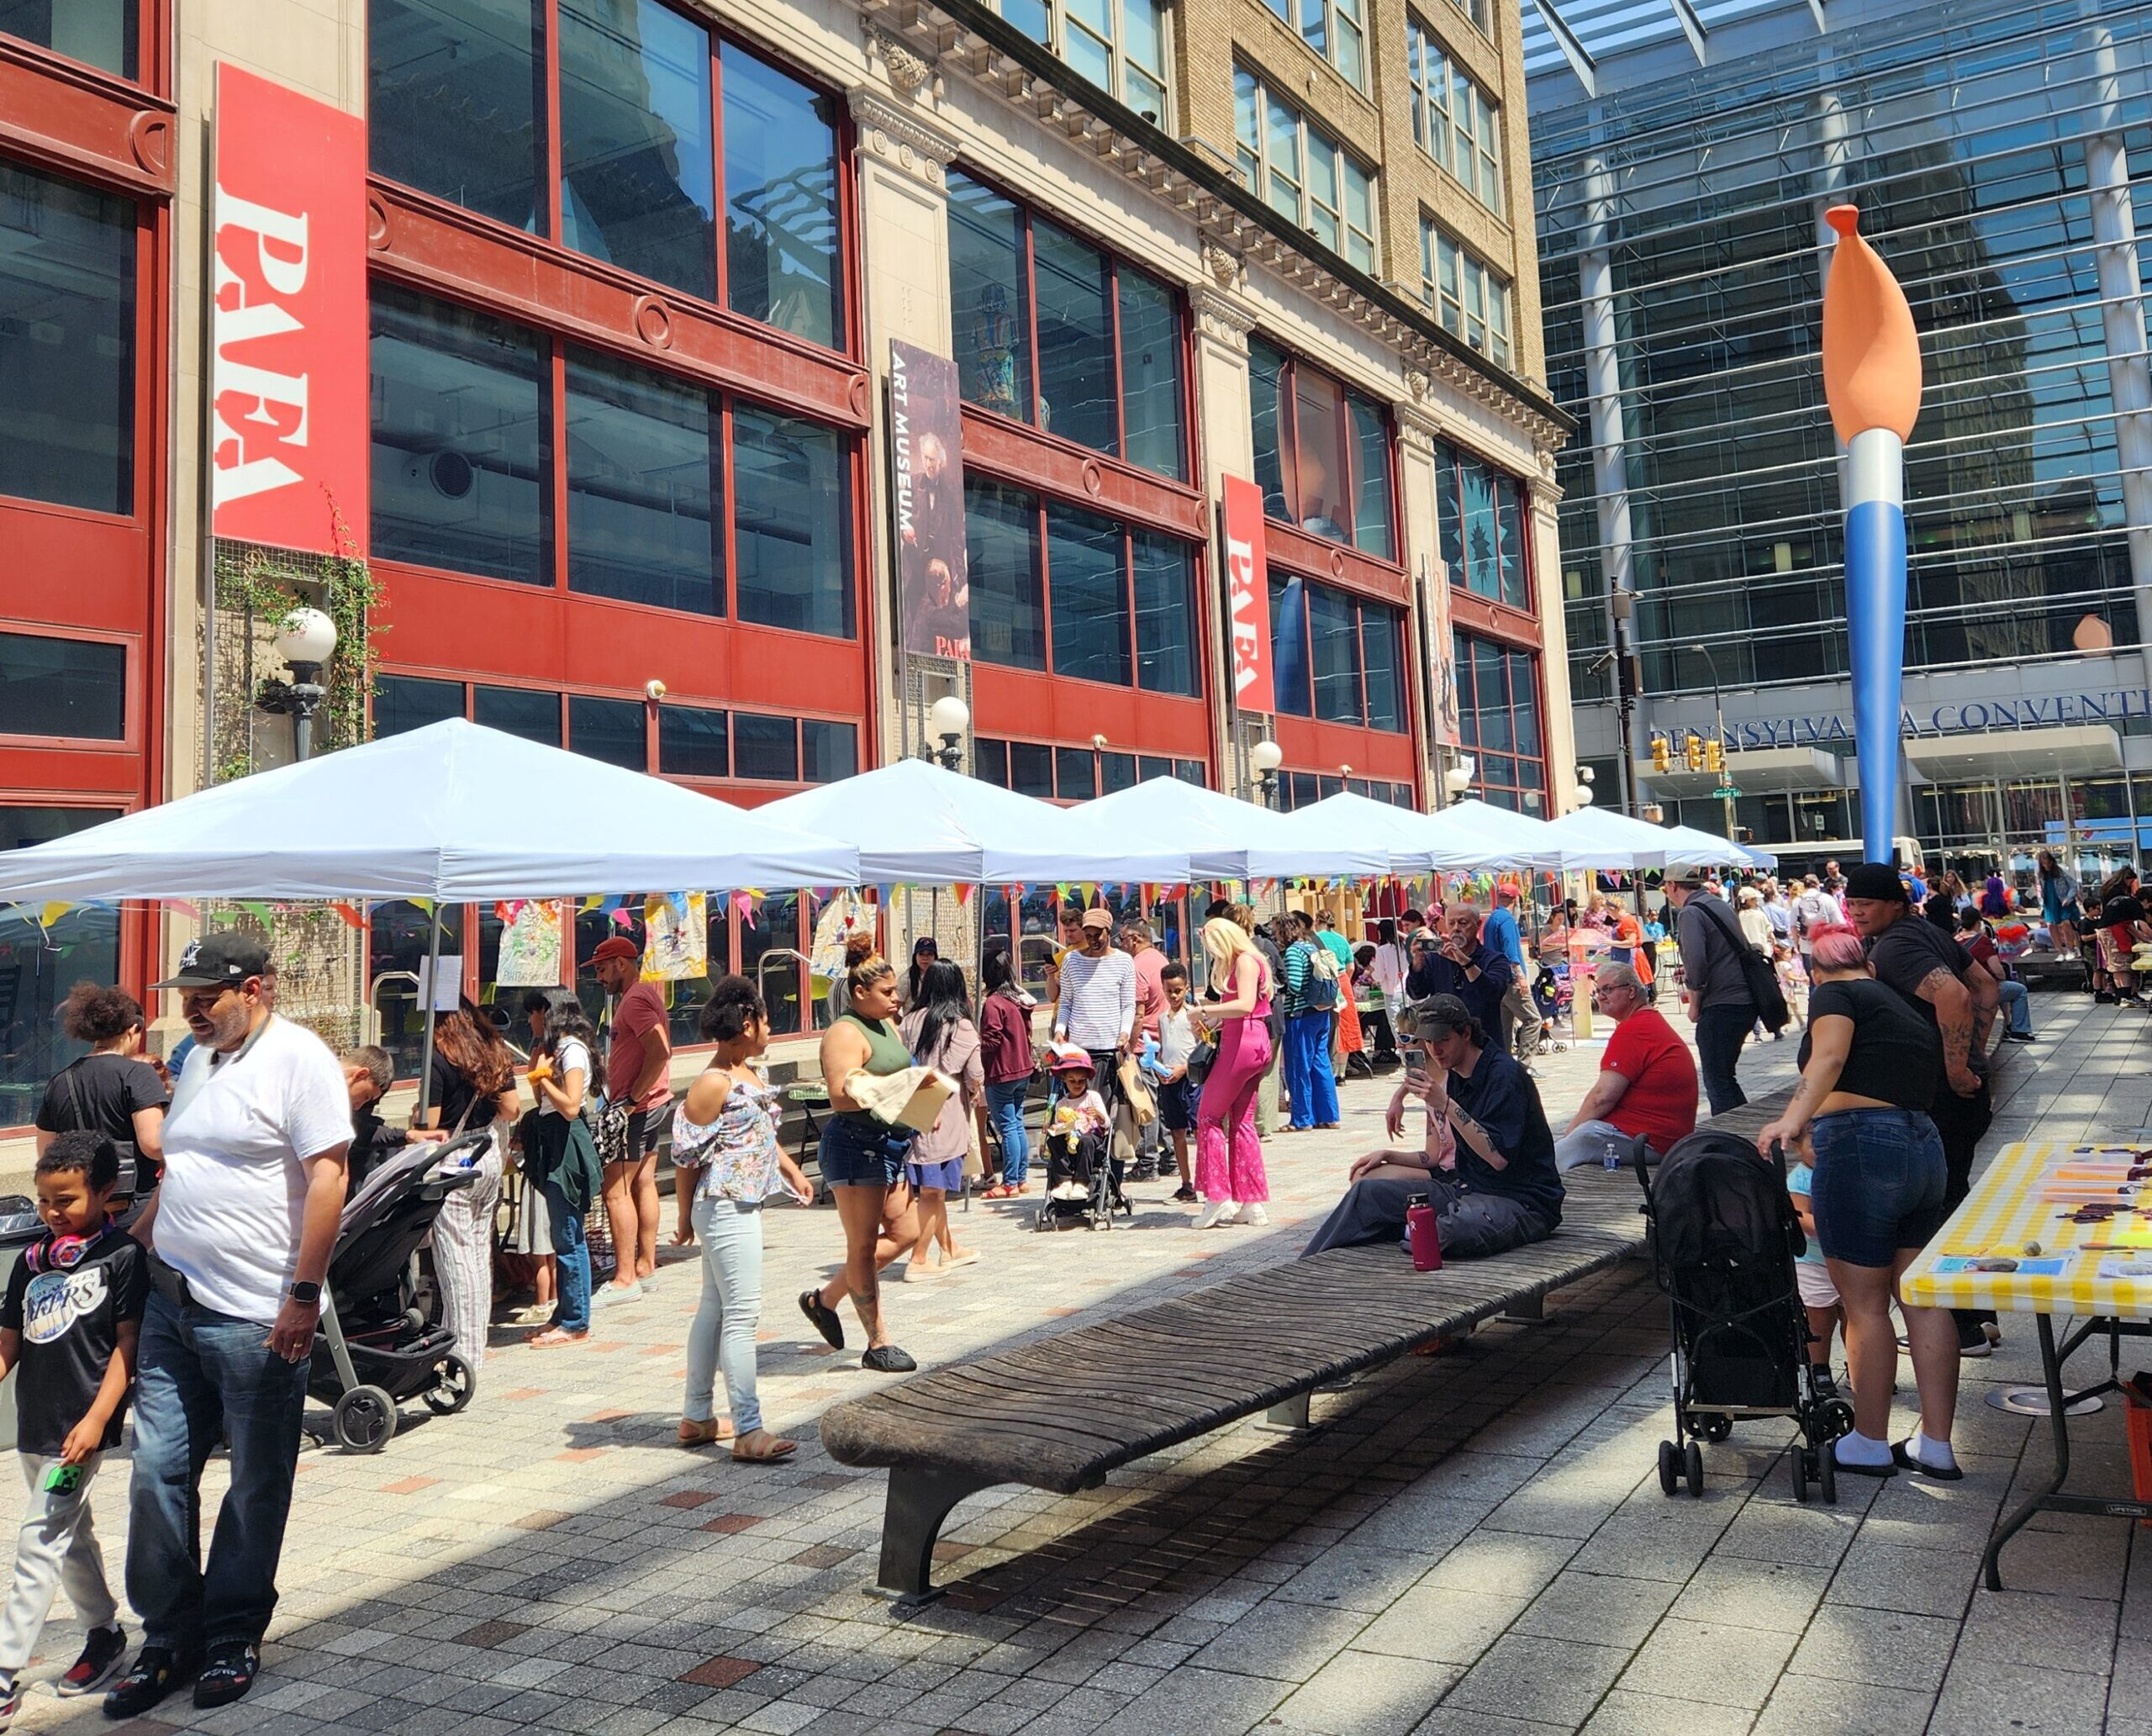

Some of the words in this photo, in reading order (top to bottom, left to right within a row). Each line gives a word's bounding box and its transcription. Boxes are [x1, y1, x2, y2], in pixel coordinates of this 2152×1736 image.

[213, 181, 308, 510] PAFA
[893, 351, 908, 407] ART
[894, 410, 915, 532] MUSEUM
[1227, 533, 1258, 696] PAFA
